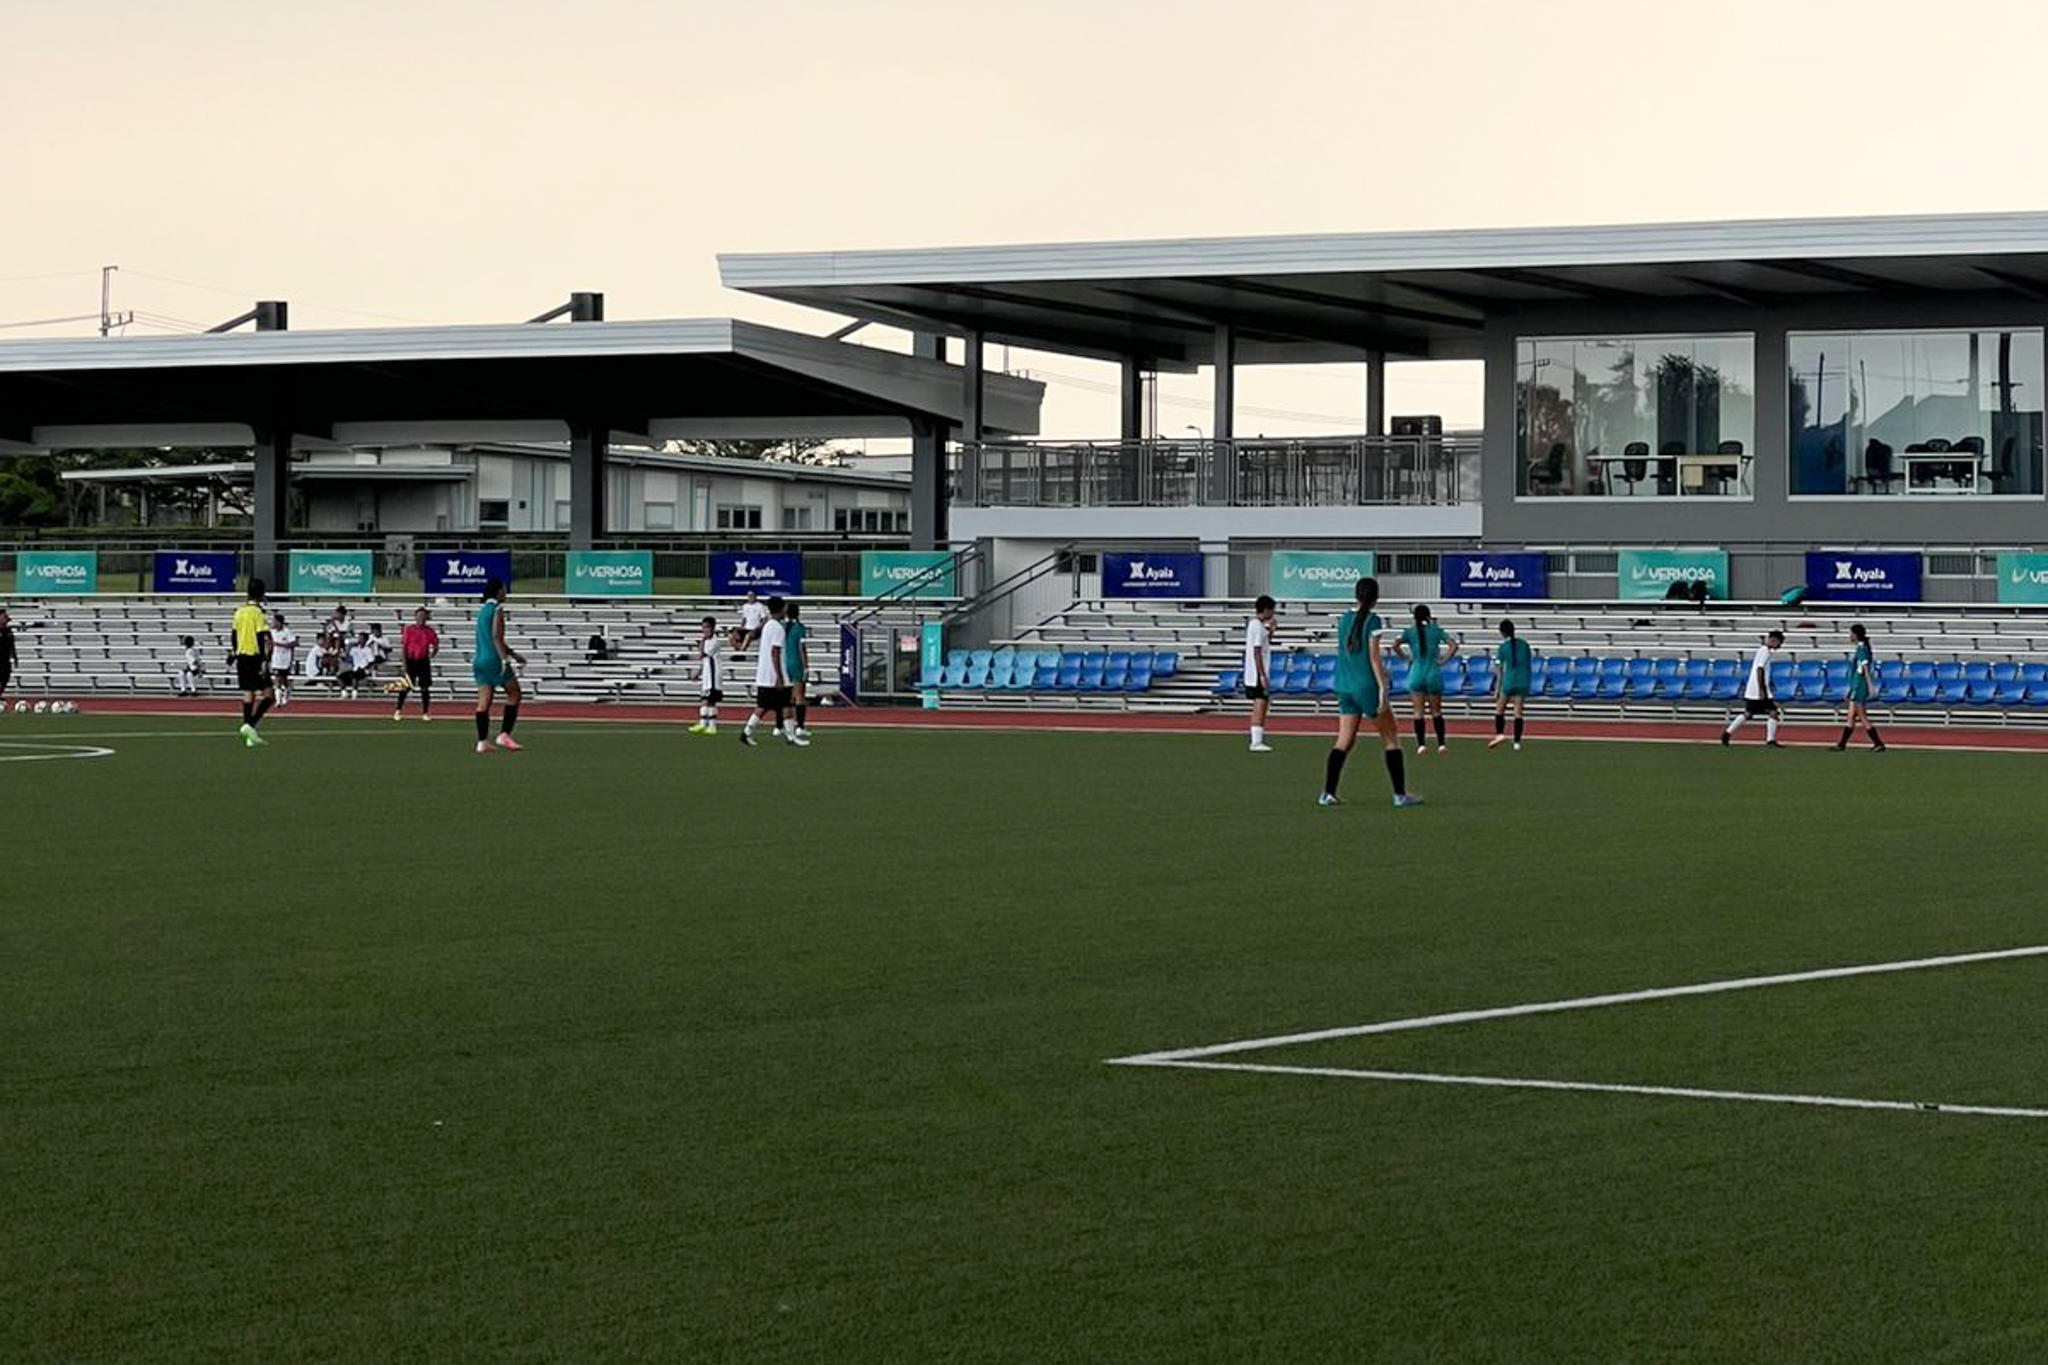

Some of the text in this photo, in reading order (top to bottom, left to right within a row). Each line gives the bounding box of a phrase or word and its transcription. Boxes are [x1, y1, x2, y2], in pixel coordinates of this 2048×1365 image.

[37, 565, 86, 577] VERMOSA
[189, 565, 212, 577] Ayala
[311, 565, 362, 577] VERMOSA
[461, 565, 485, 577] Ayala
[588, 565, 643, 577] VERMOSA
[749, 566, 776, 579] Ayala
[1146, 567, 1174, 580] Ayala
[1298, 567, 1361, 580] VERMOSA
[1485, 567, 1515, 581] Ayala
[1648, 566, 1716, 580] VERMOSA
[1853, 567, 1886, 582] Ayala
